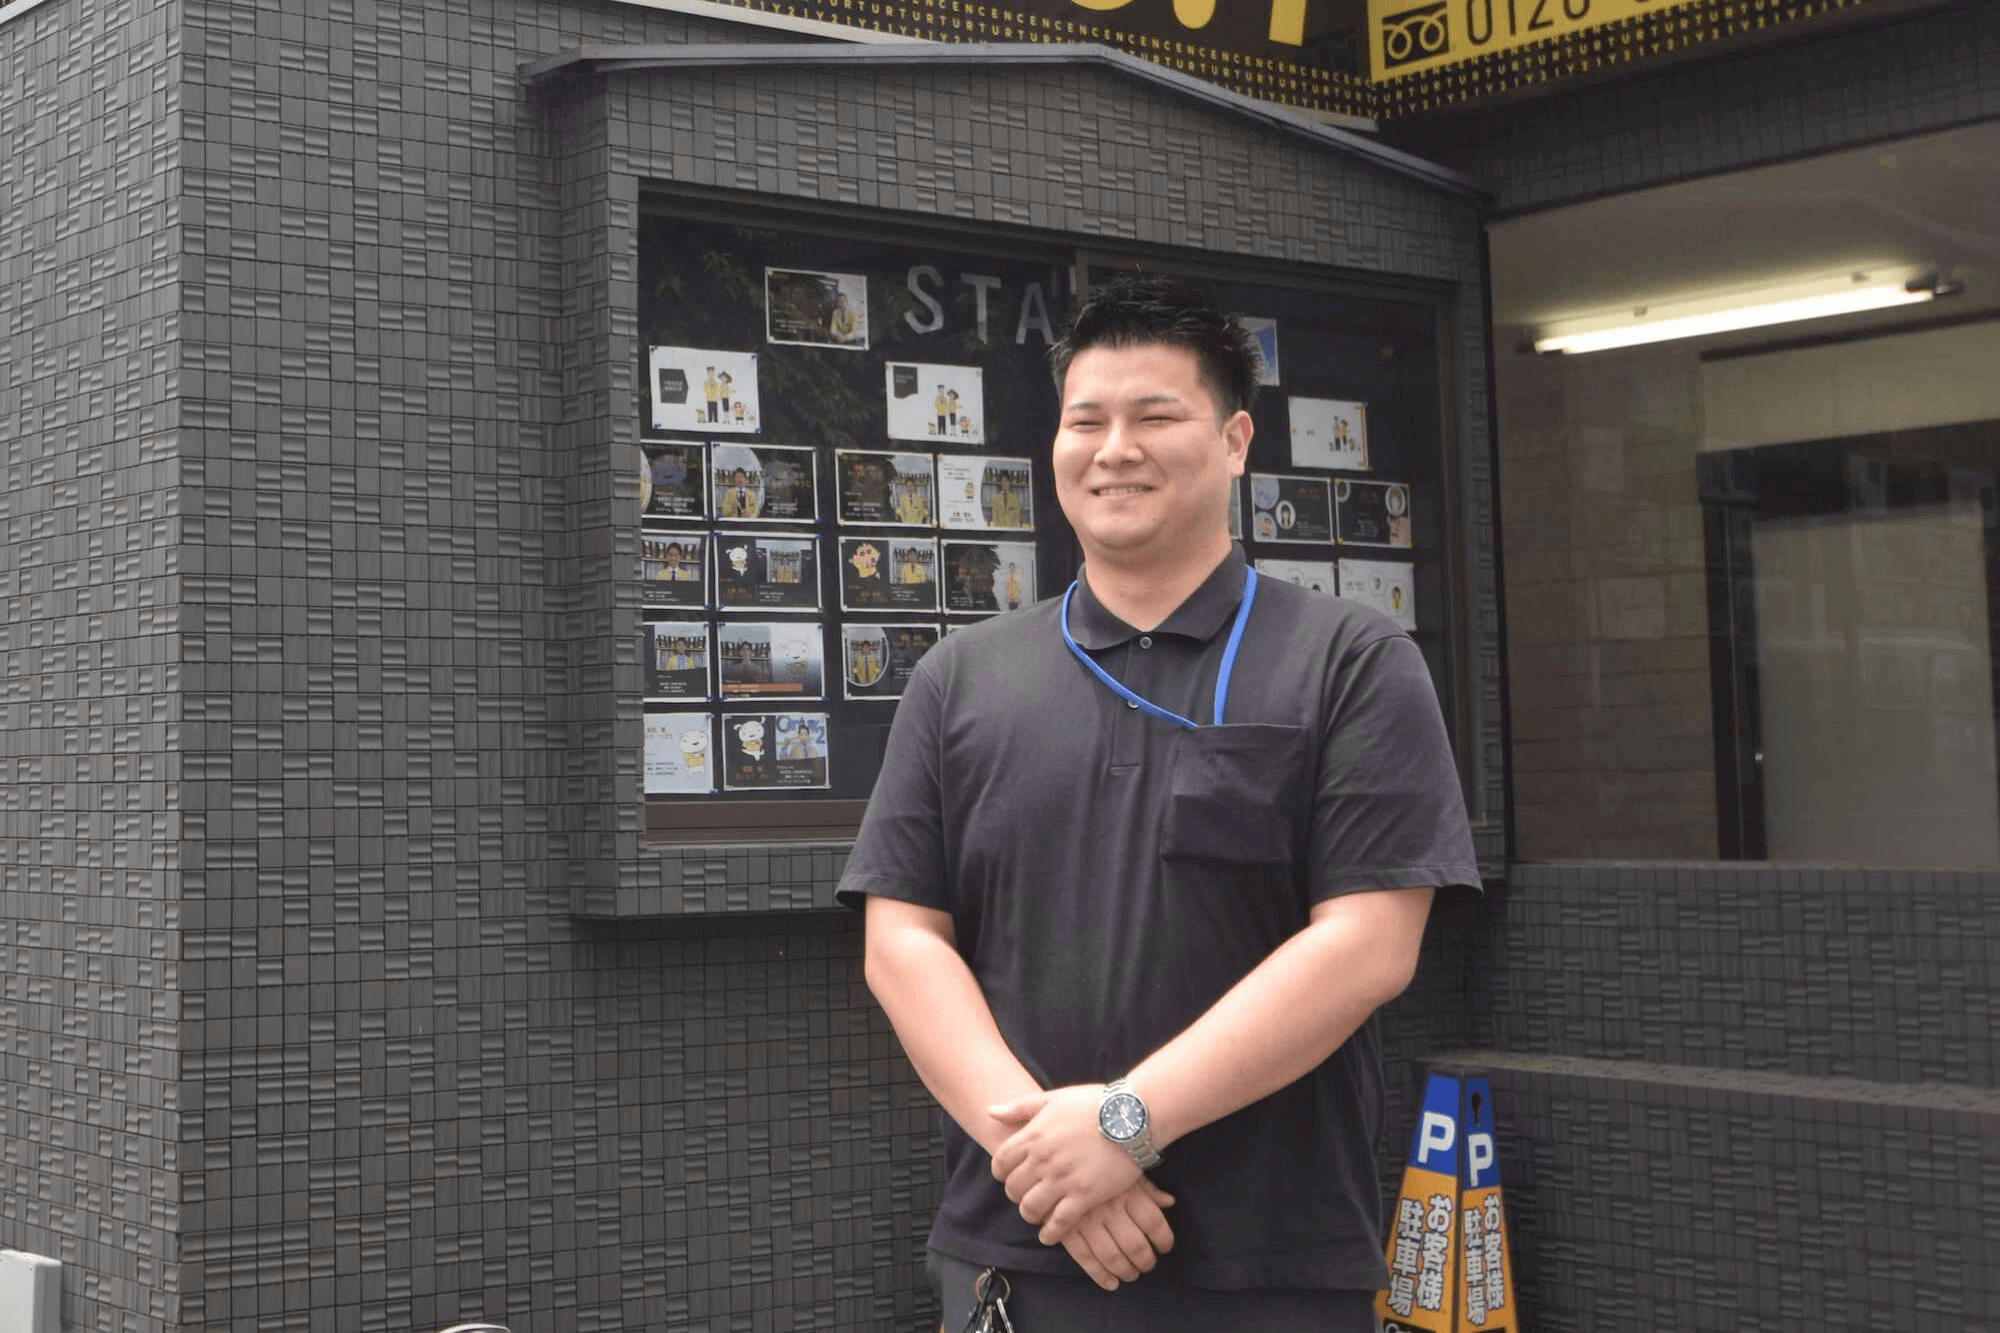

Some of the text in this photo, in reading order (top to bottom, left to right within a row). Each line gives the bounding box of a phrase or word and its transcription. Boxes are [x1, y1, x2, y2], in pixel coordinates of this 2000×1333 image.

[1417, 1110, 1456, 1164] P
[1467, 1132, 1494, 1187] P
[1386, 1197, 1424, 1318] 駐車場
[1417, 1194, 1453, 1311] お客様
[1463, 1207, 1488, 1327] 駐車場
[1484, 1194, 1505, 1311] お客様
